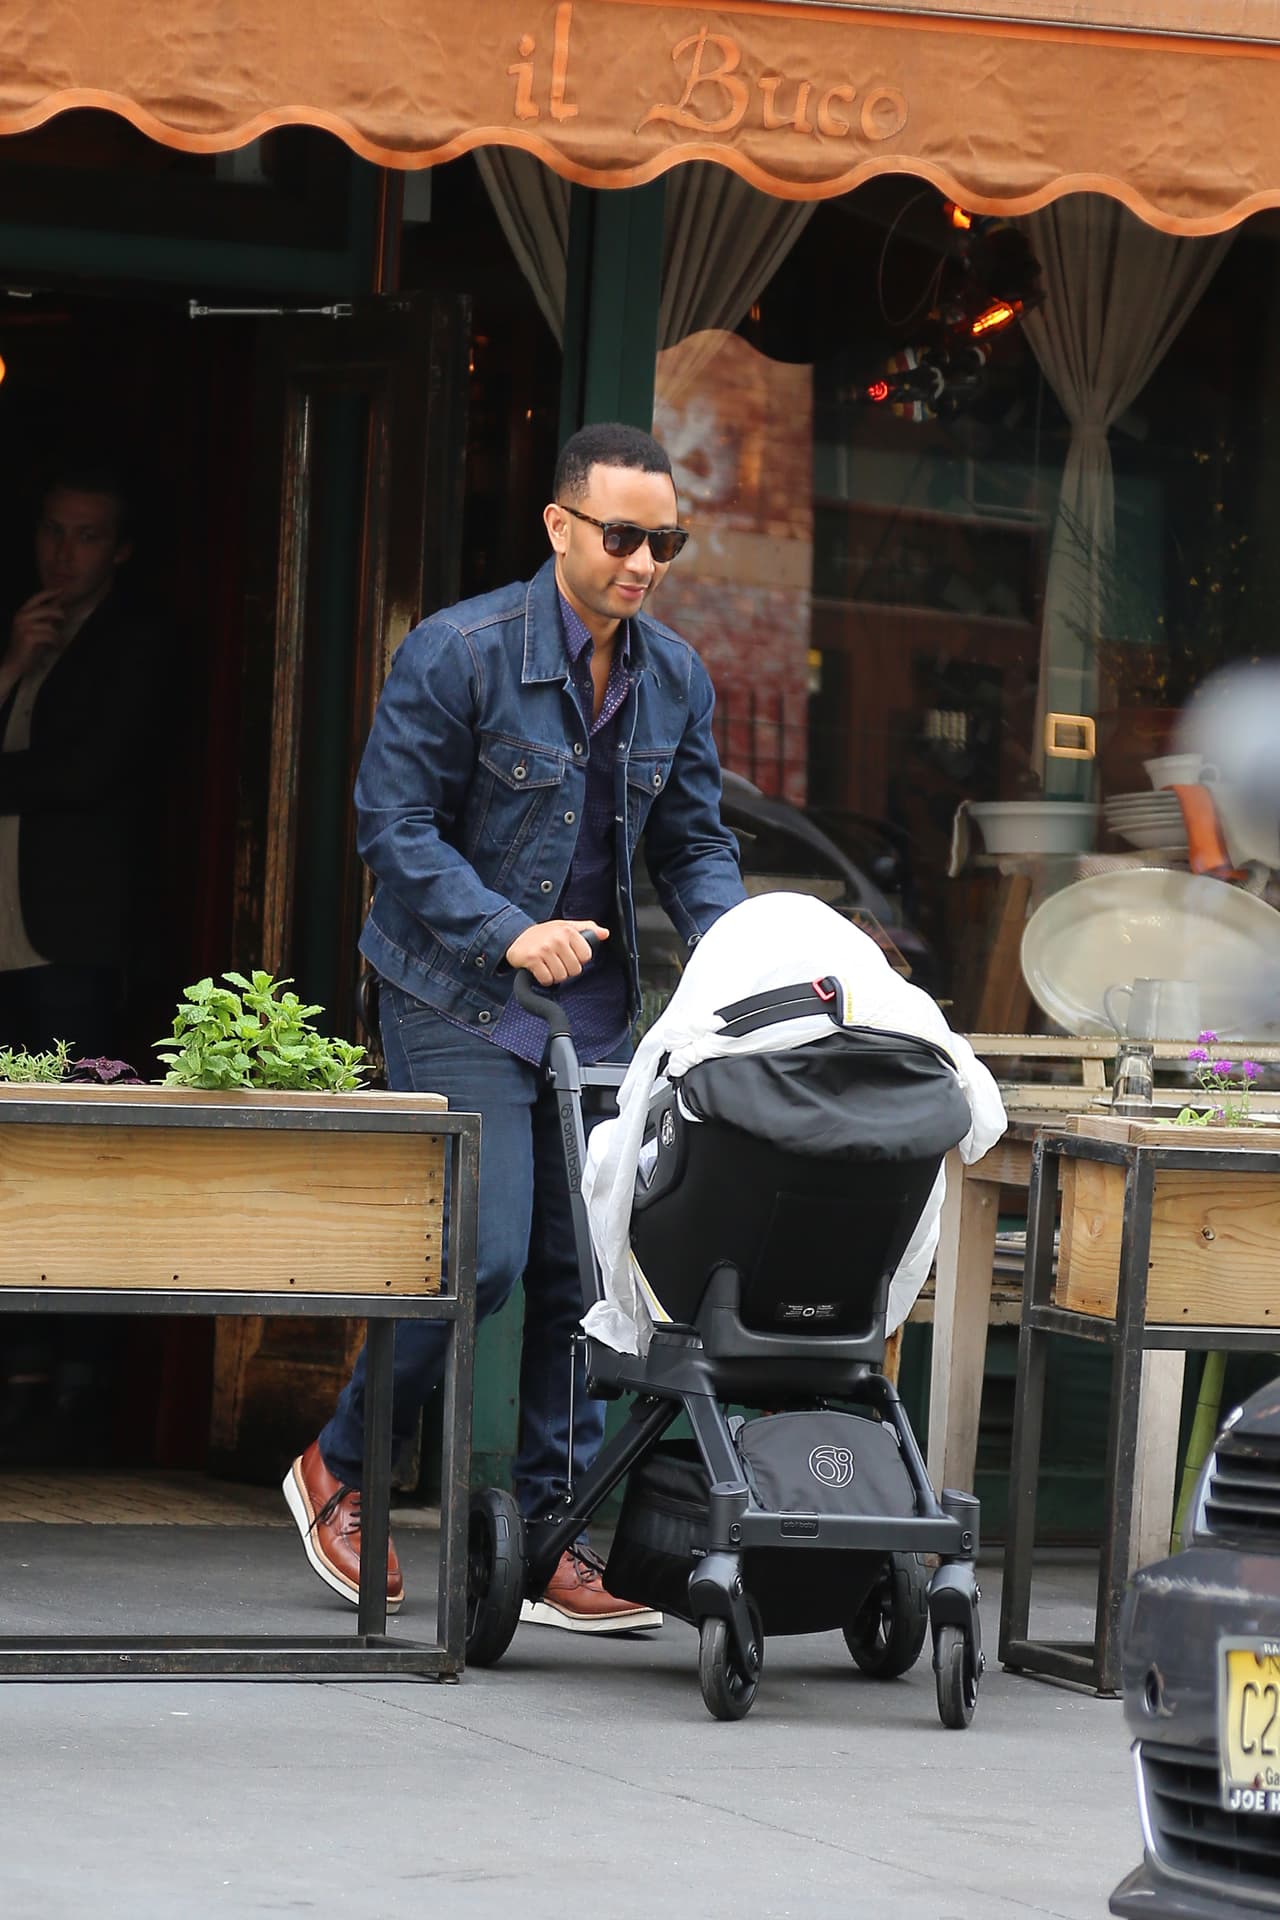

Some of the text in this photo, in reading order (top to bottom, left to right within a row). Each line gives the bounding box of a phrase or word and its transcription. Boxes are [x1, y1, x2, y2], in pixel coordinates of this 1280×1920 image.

[508, 1, 910, 141] il Buco
[1240, 1681, 1280, 1756] C2
[1230, 1788, 1265, 1810] JOE
